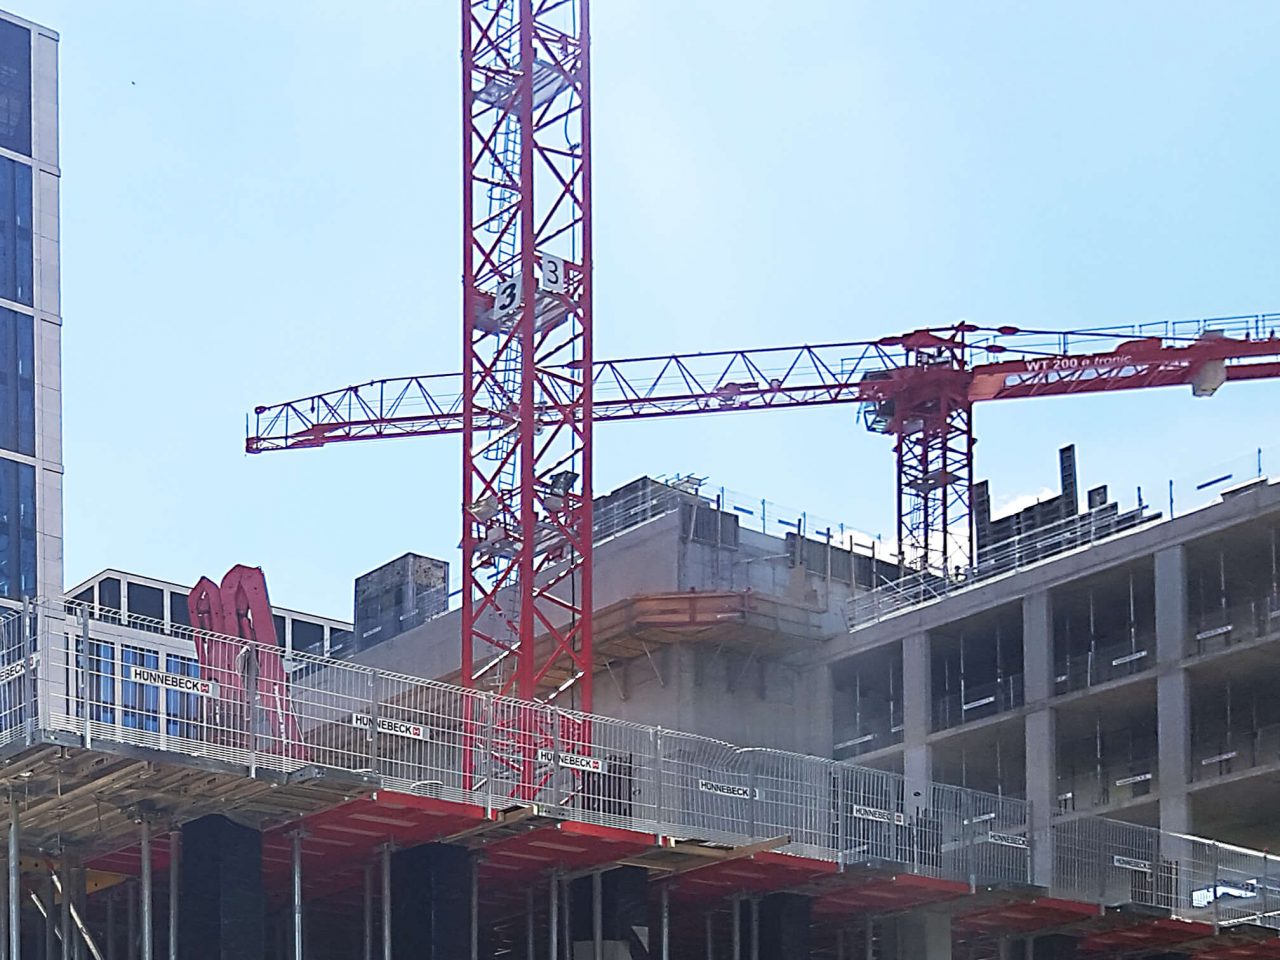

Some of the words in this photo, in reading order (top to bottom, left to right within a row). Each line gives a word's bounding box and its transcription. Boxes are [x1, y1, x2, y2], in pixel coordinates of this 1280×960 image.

[547, 260, 559, 285] 3
[499, 283, 517, 311] 3
[1026, 360, 1050, 372] WT
[1053, 358, 1078, 370] 200
[1094, 354, 1132, 365] tronic
[540, 751, 592, 769] HÜNEBECK
